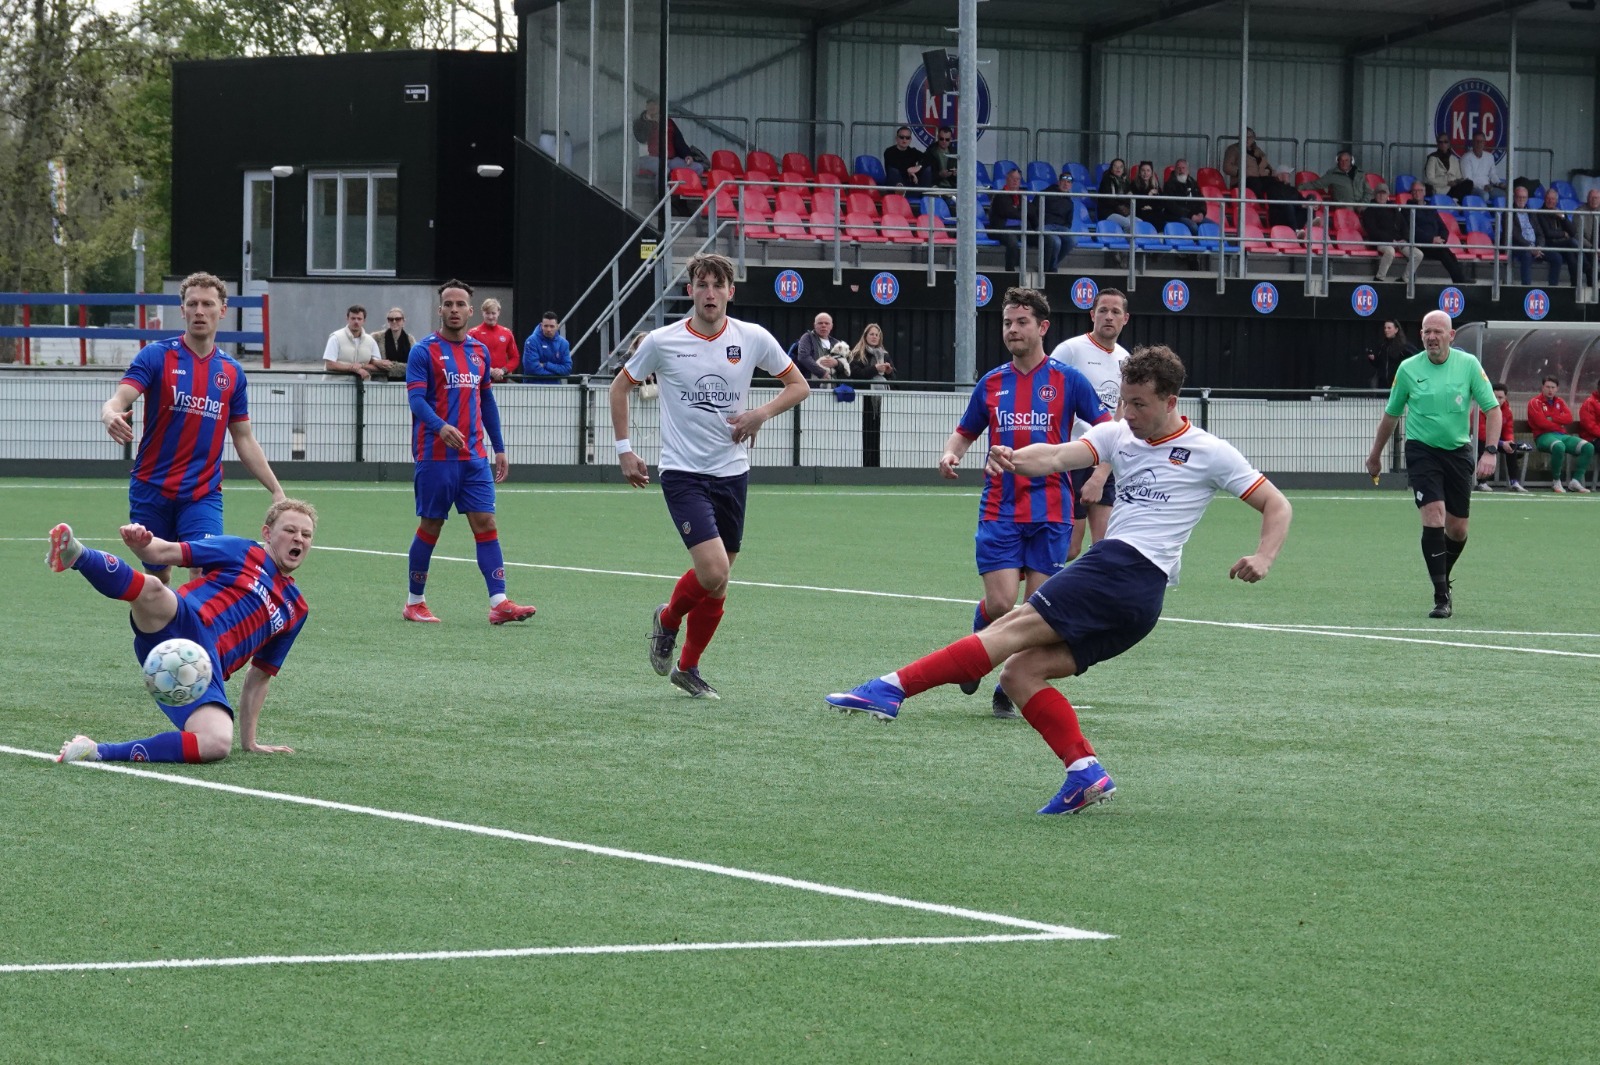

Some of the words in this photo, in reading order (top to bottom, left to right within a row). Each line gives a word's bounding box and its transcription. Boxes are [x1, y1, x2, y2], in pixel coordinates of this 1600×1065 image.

[1452, 111, 1495, 142] KFC
[781, 280, 797, 292] KFC
[877, 282, 893, 294] KFC
[976, 285, 987, 296] FC
[1077, 287, 1093, 299] KFC
[1168, 290, 1183, 301] KFC
[1257, 292, 1273, 303] KFC
[1357, 295, 1372, 306] KFC
[1444, 297, 1459, 308] KFC
[1529, 299, 1544, 310] KFC
[698, 382, 725, 391] HOTEL
[680, 391, 741, 402] ZUIDERDUIN
[995, 389, 1009, 397] JAKO
[171, 385, 224, 414] Visscher
[994, 406, 1055, 426] Visscher
